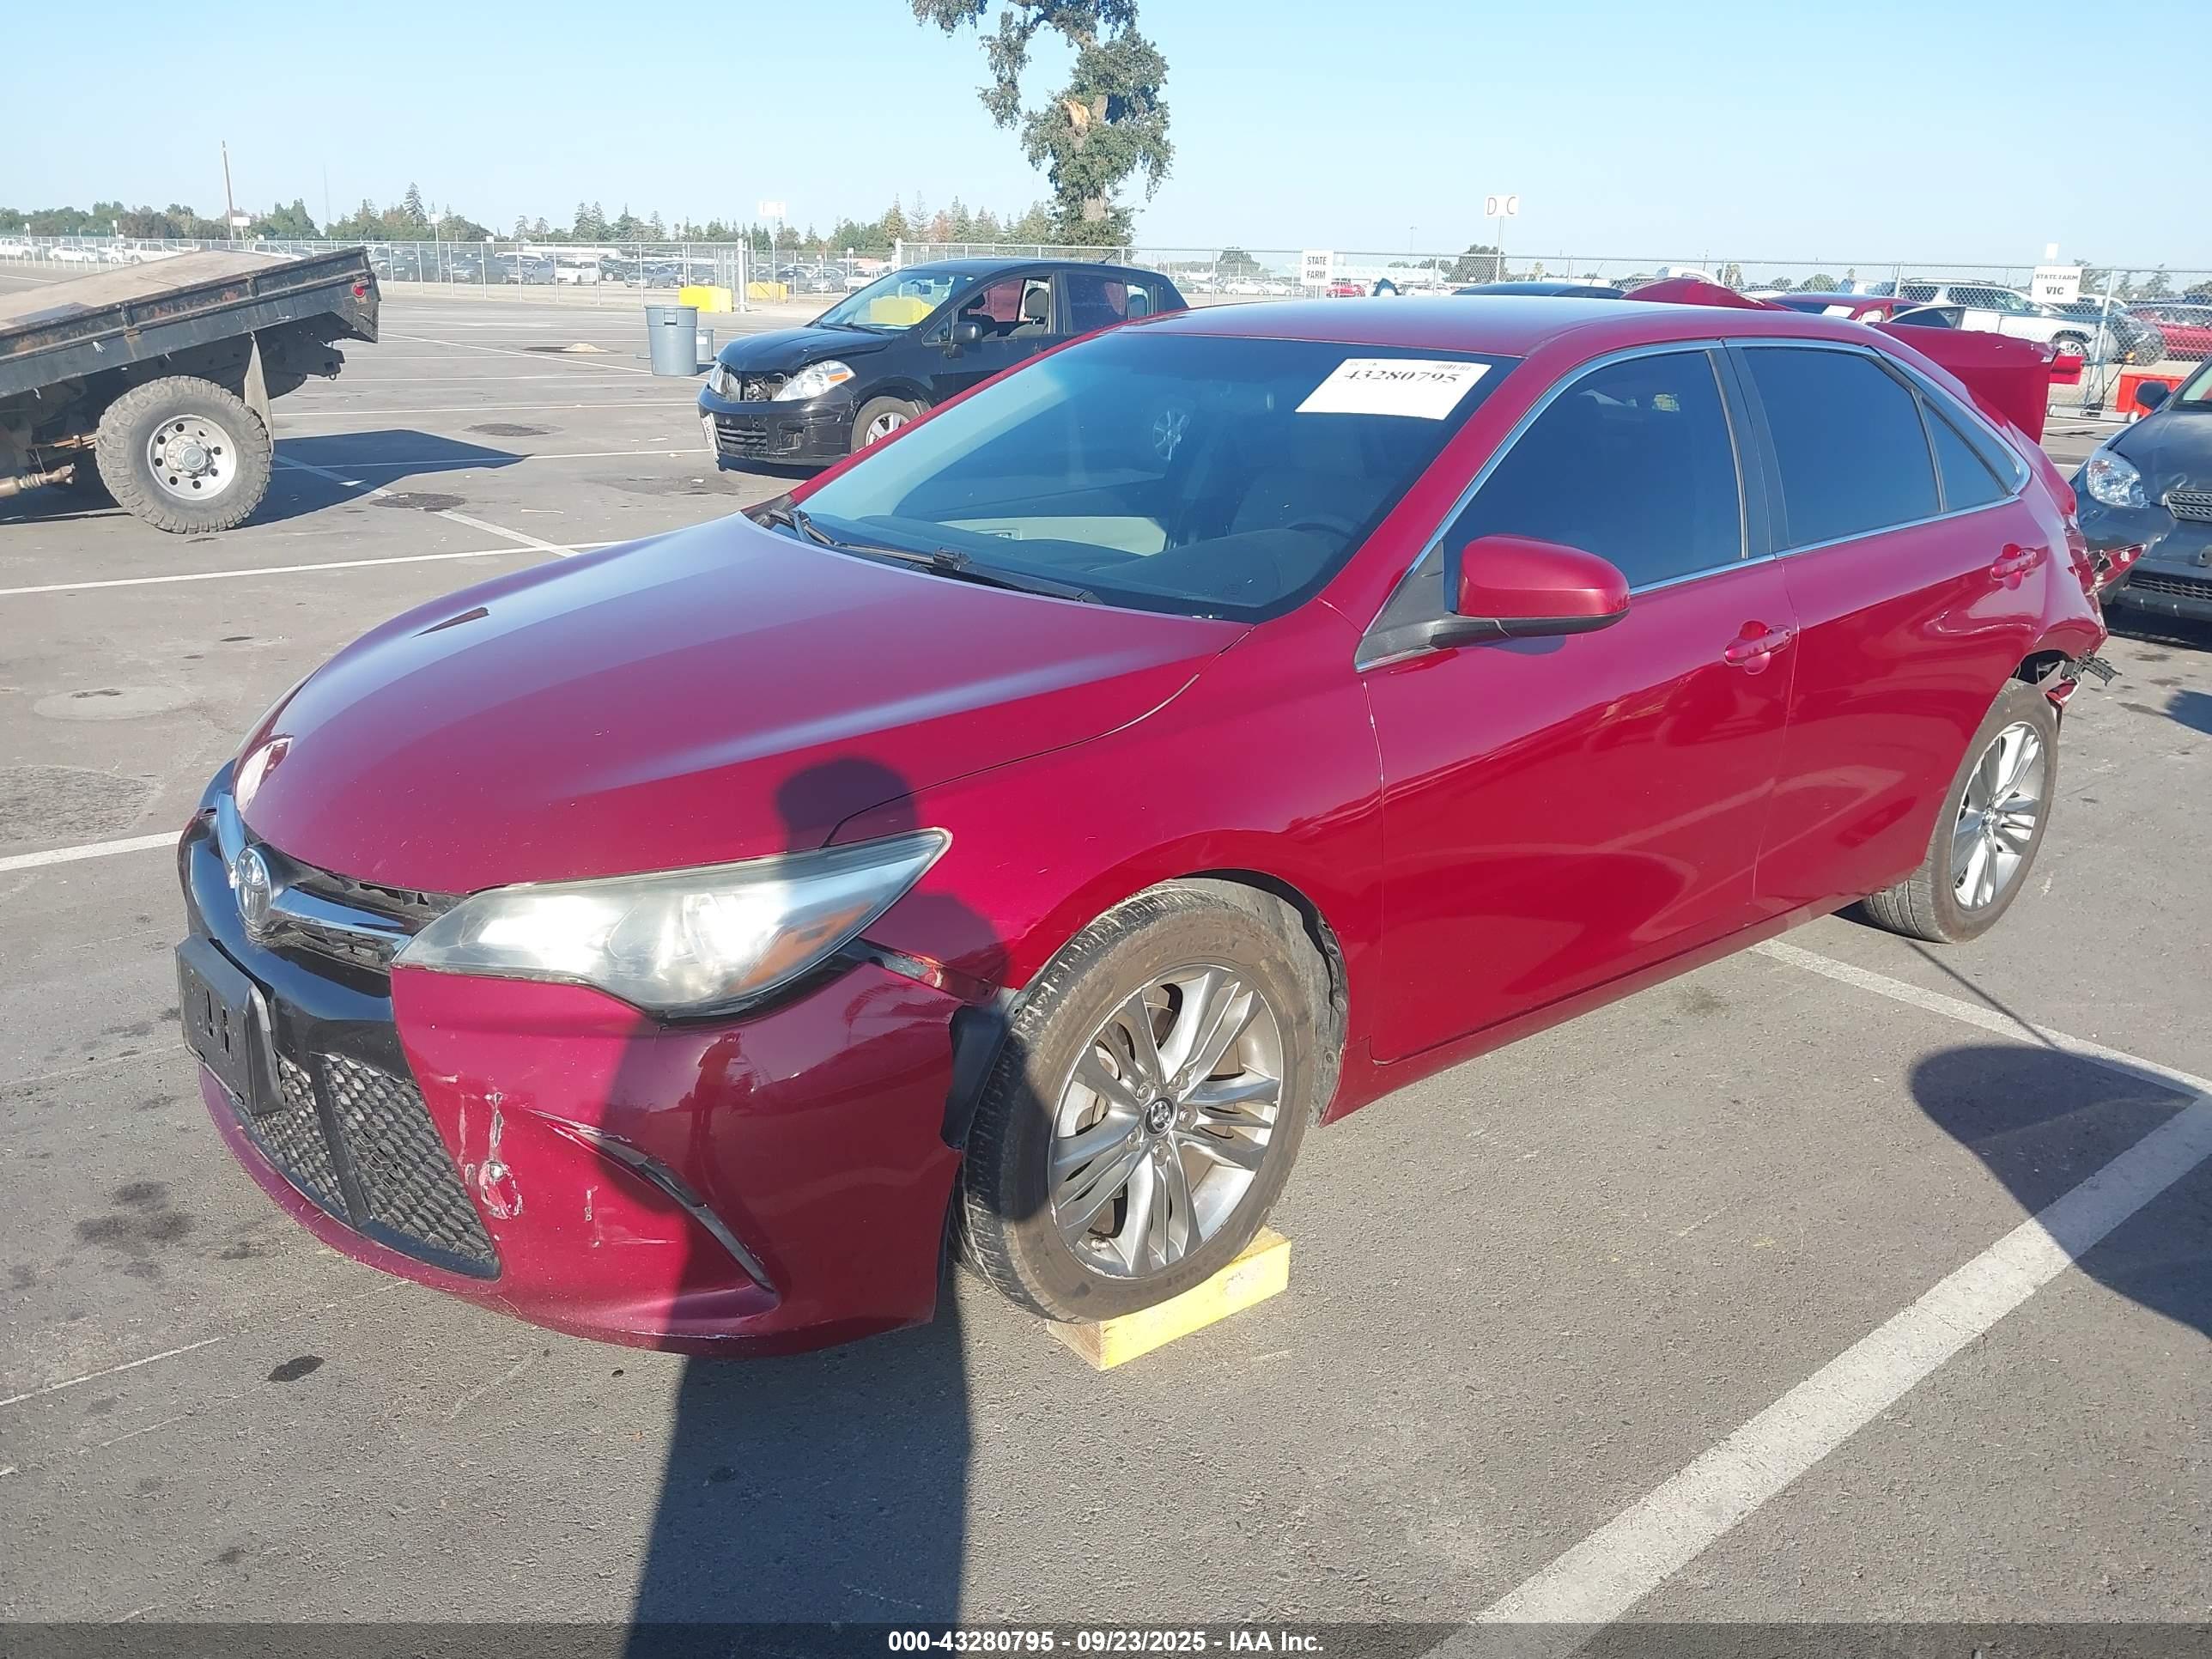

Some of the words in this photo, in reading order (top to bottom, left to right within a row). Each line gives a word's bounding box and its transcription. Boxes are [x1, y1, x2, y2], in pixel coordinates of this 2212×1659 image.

[1487, 198, 1497, 215] D
[1507, 197, 1516, 215] C
[1307, 256, 1327, 265] STATE
[1306, 270, 1326, 280] FARM
[2045, 286, 2064, 295] VIC
[1344, 370, 1462, 383] 43280795
